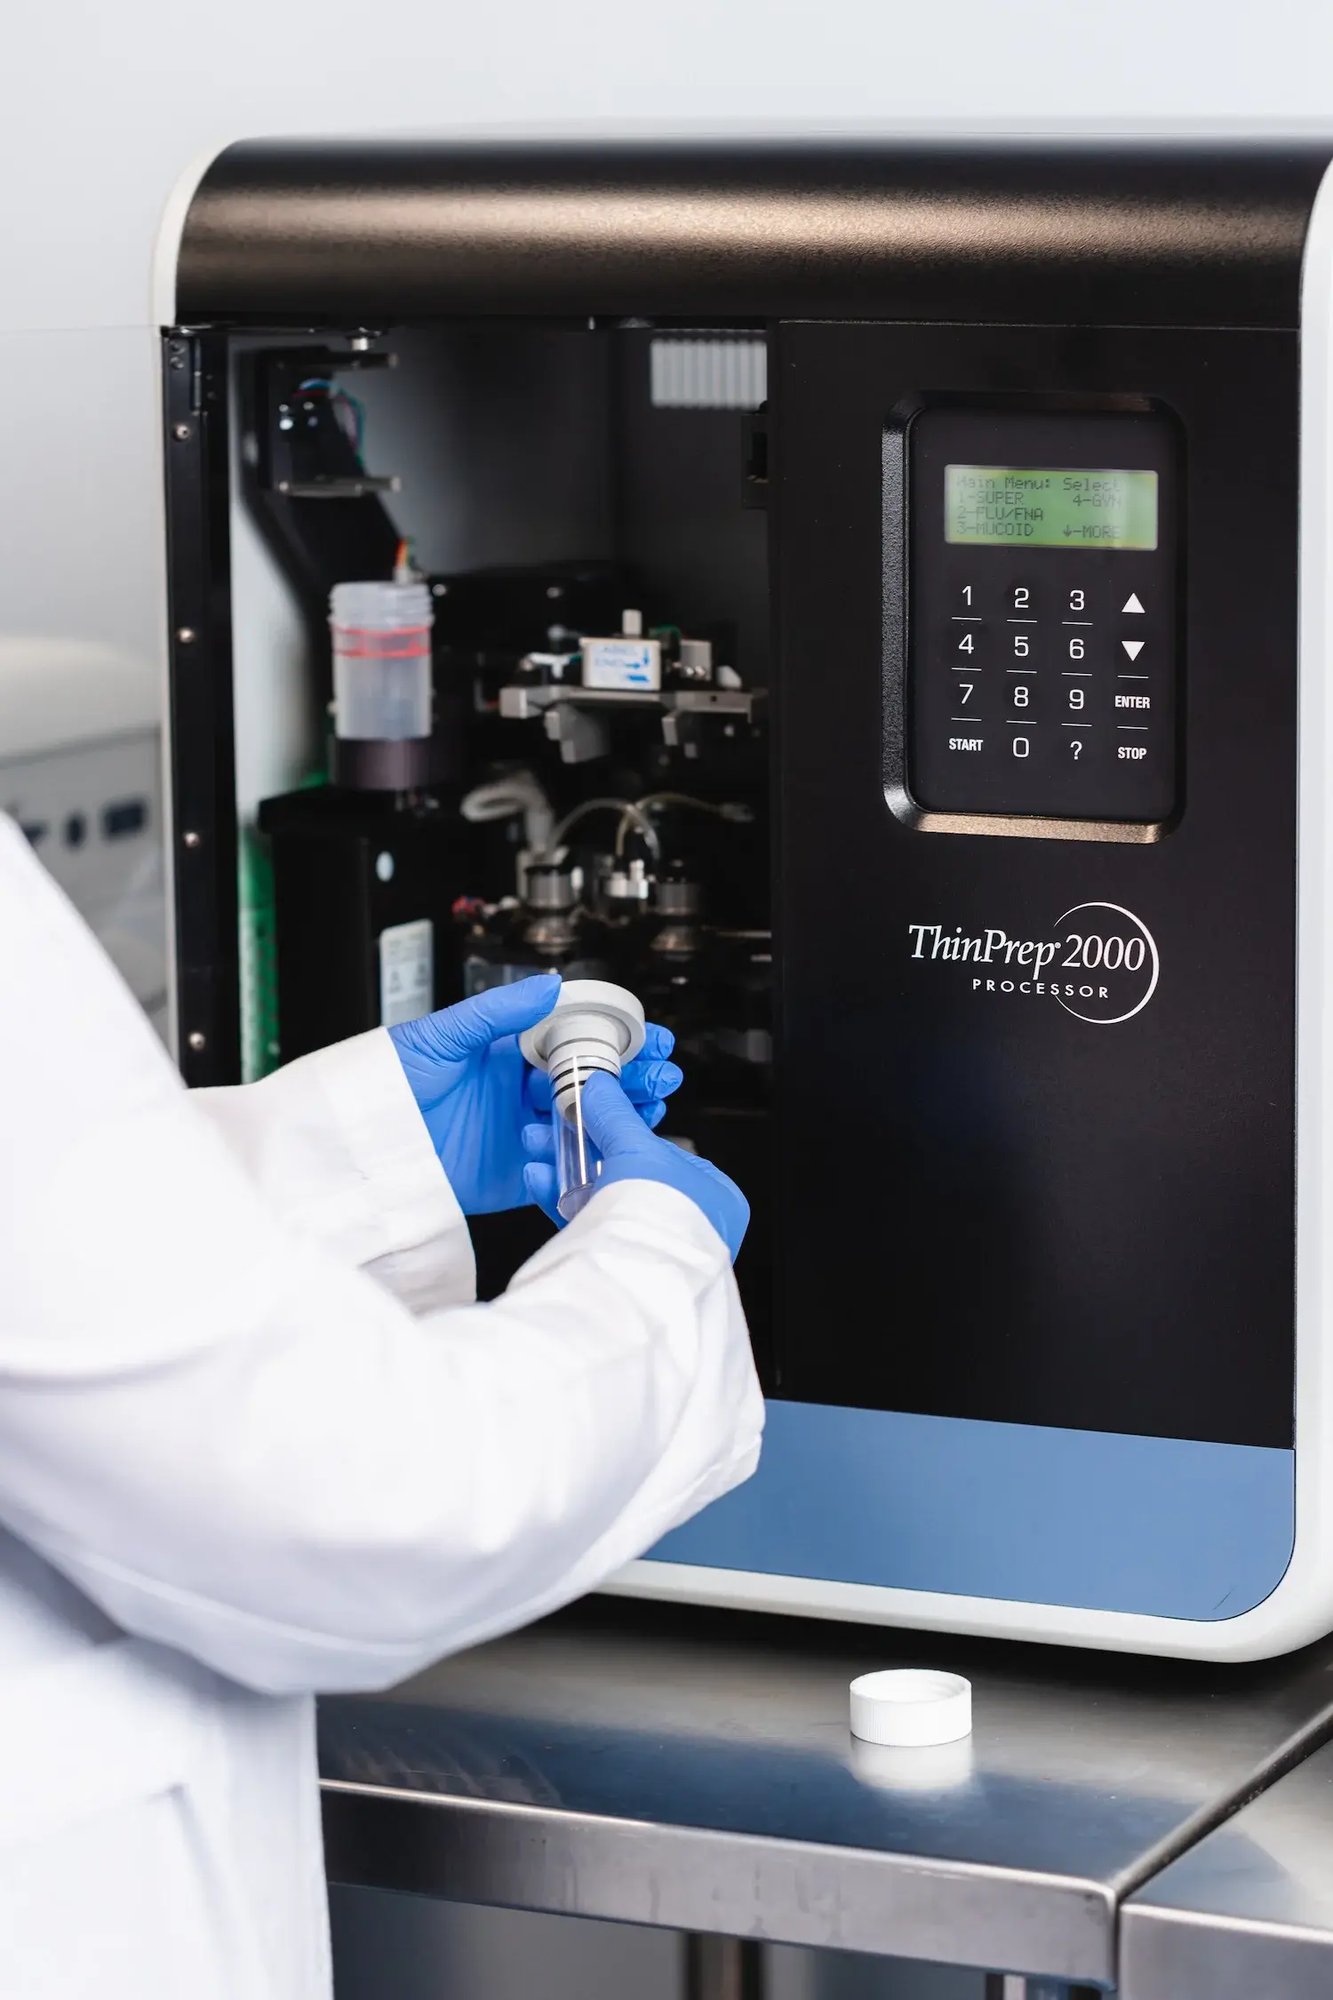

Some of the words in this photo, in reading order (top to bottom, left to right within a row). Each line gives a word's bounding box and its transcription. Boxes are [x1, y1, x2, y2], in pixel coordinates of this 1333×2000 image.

[957, 477, 995, 488] Main
[1005, 477, 1050, 490] Menu:
[1063, 478, 1122, 491] Select
[958, 491, 1024, 505] 1-SUPER
[957, 523, 1033, 536] 3-MUCOID
[962, 586, 971, 606] 1
[1015, 588, 1029, 608] 2
[1070, 590, 1084, 610] 3
[958, 634, 974, 654] 4
[1015, 636, 1028, 656] 5
[1070, 639, 1084, 659] 6
[959, 684, 973, 704] 7
[1014, 687, 1028, 707] 8
[1069, 689, 1084, 709] 9
[1115, 696, 1150, 709] ENTER
[949, 738, 983, 751] START
[1013, 738, 1029, 757] 0
[1070, 741, 1082, 759] ?
[1118, 747, 1146, 759] STOP
[1062, 934, 1145, 971] 2000
[972, 978, 1108, 998] PROCESSOR
